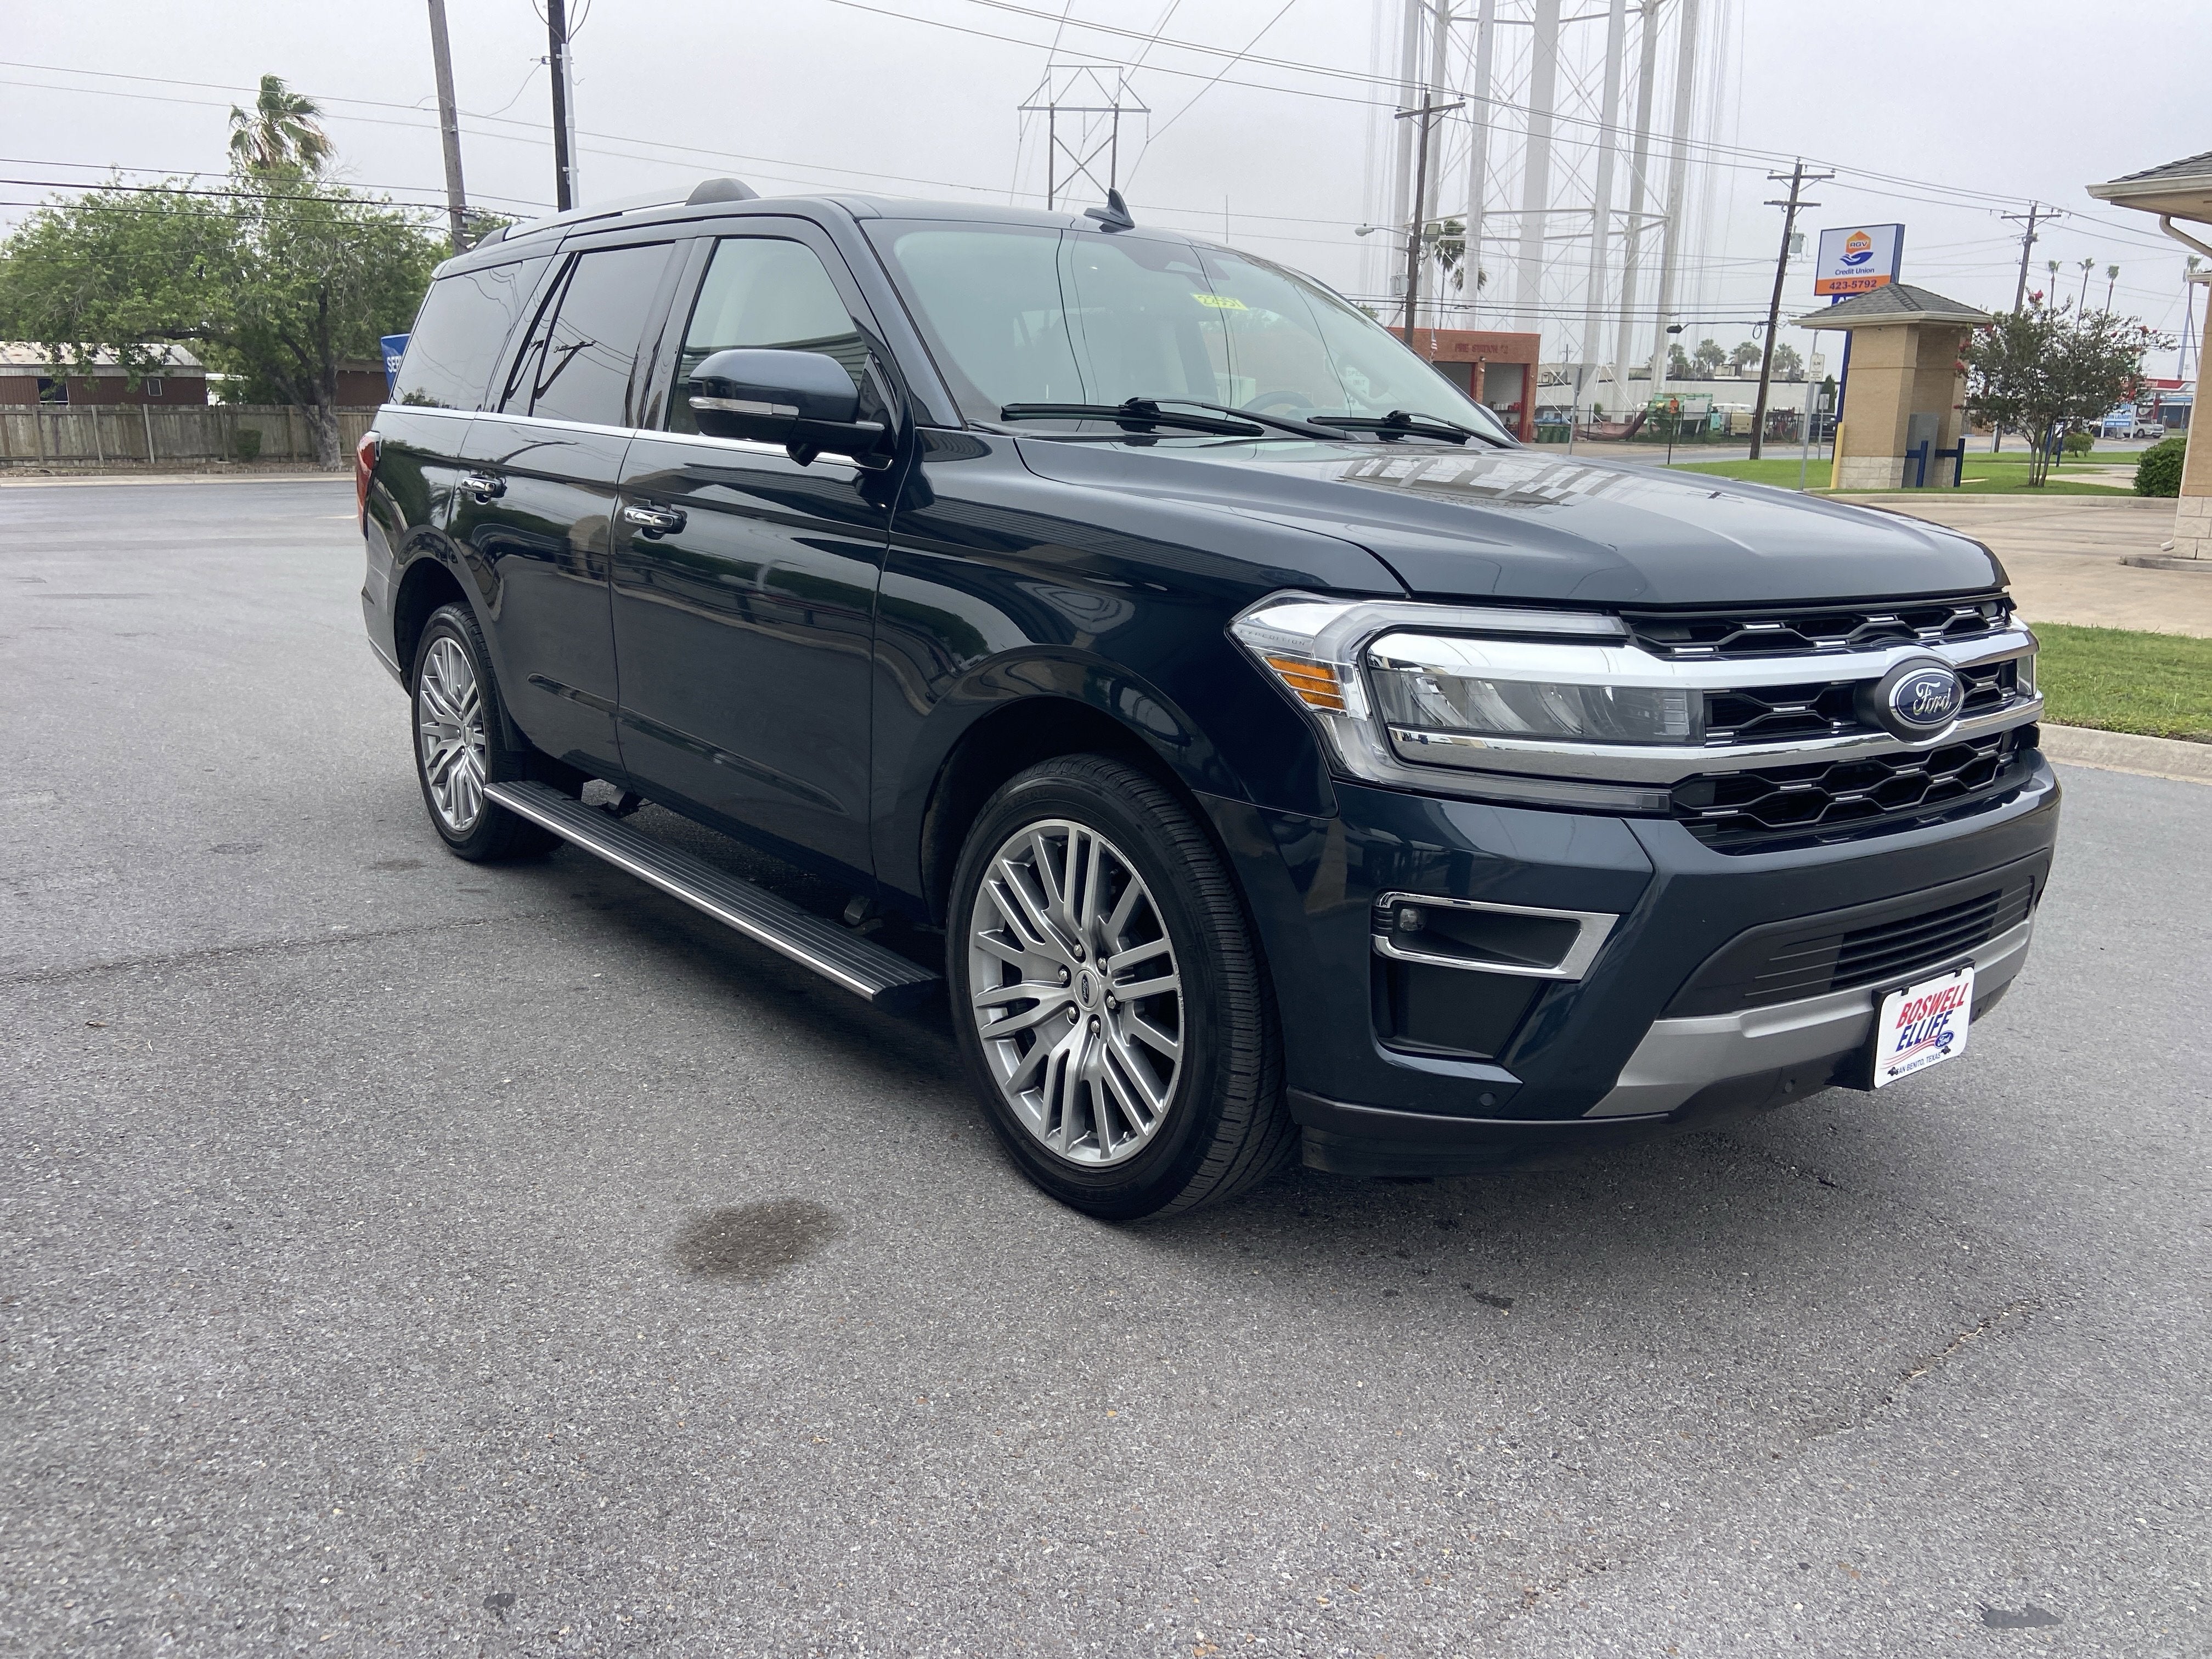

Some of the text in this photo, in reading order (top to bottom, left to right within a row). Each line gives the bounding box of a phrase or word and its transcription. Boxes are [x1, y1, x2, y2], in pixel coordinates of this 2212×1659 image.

[1829, 279, 1877, 290] 423-5792
[1240, 629, 1305, 646] EXPEDITION
[1913, 681, 1952, 715] Ford
[1895, 983, 1969, 1029] BOSWELL
[1895, 1009, 1954, 1052] ELLIFF
[1906, 1058, 1925, 1071] BENITO,
[1926, 1053, 1941, 1063] TEXAS
